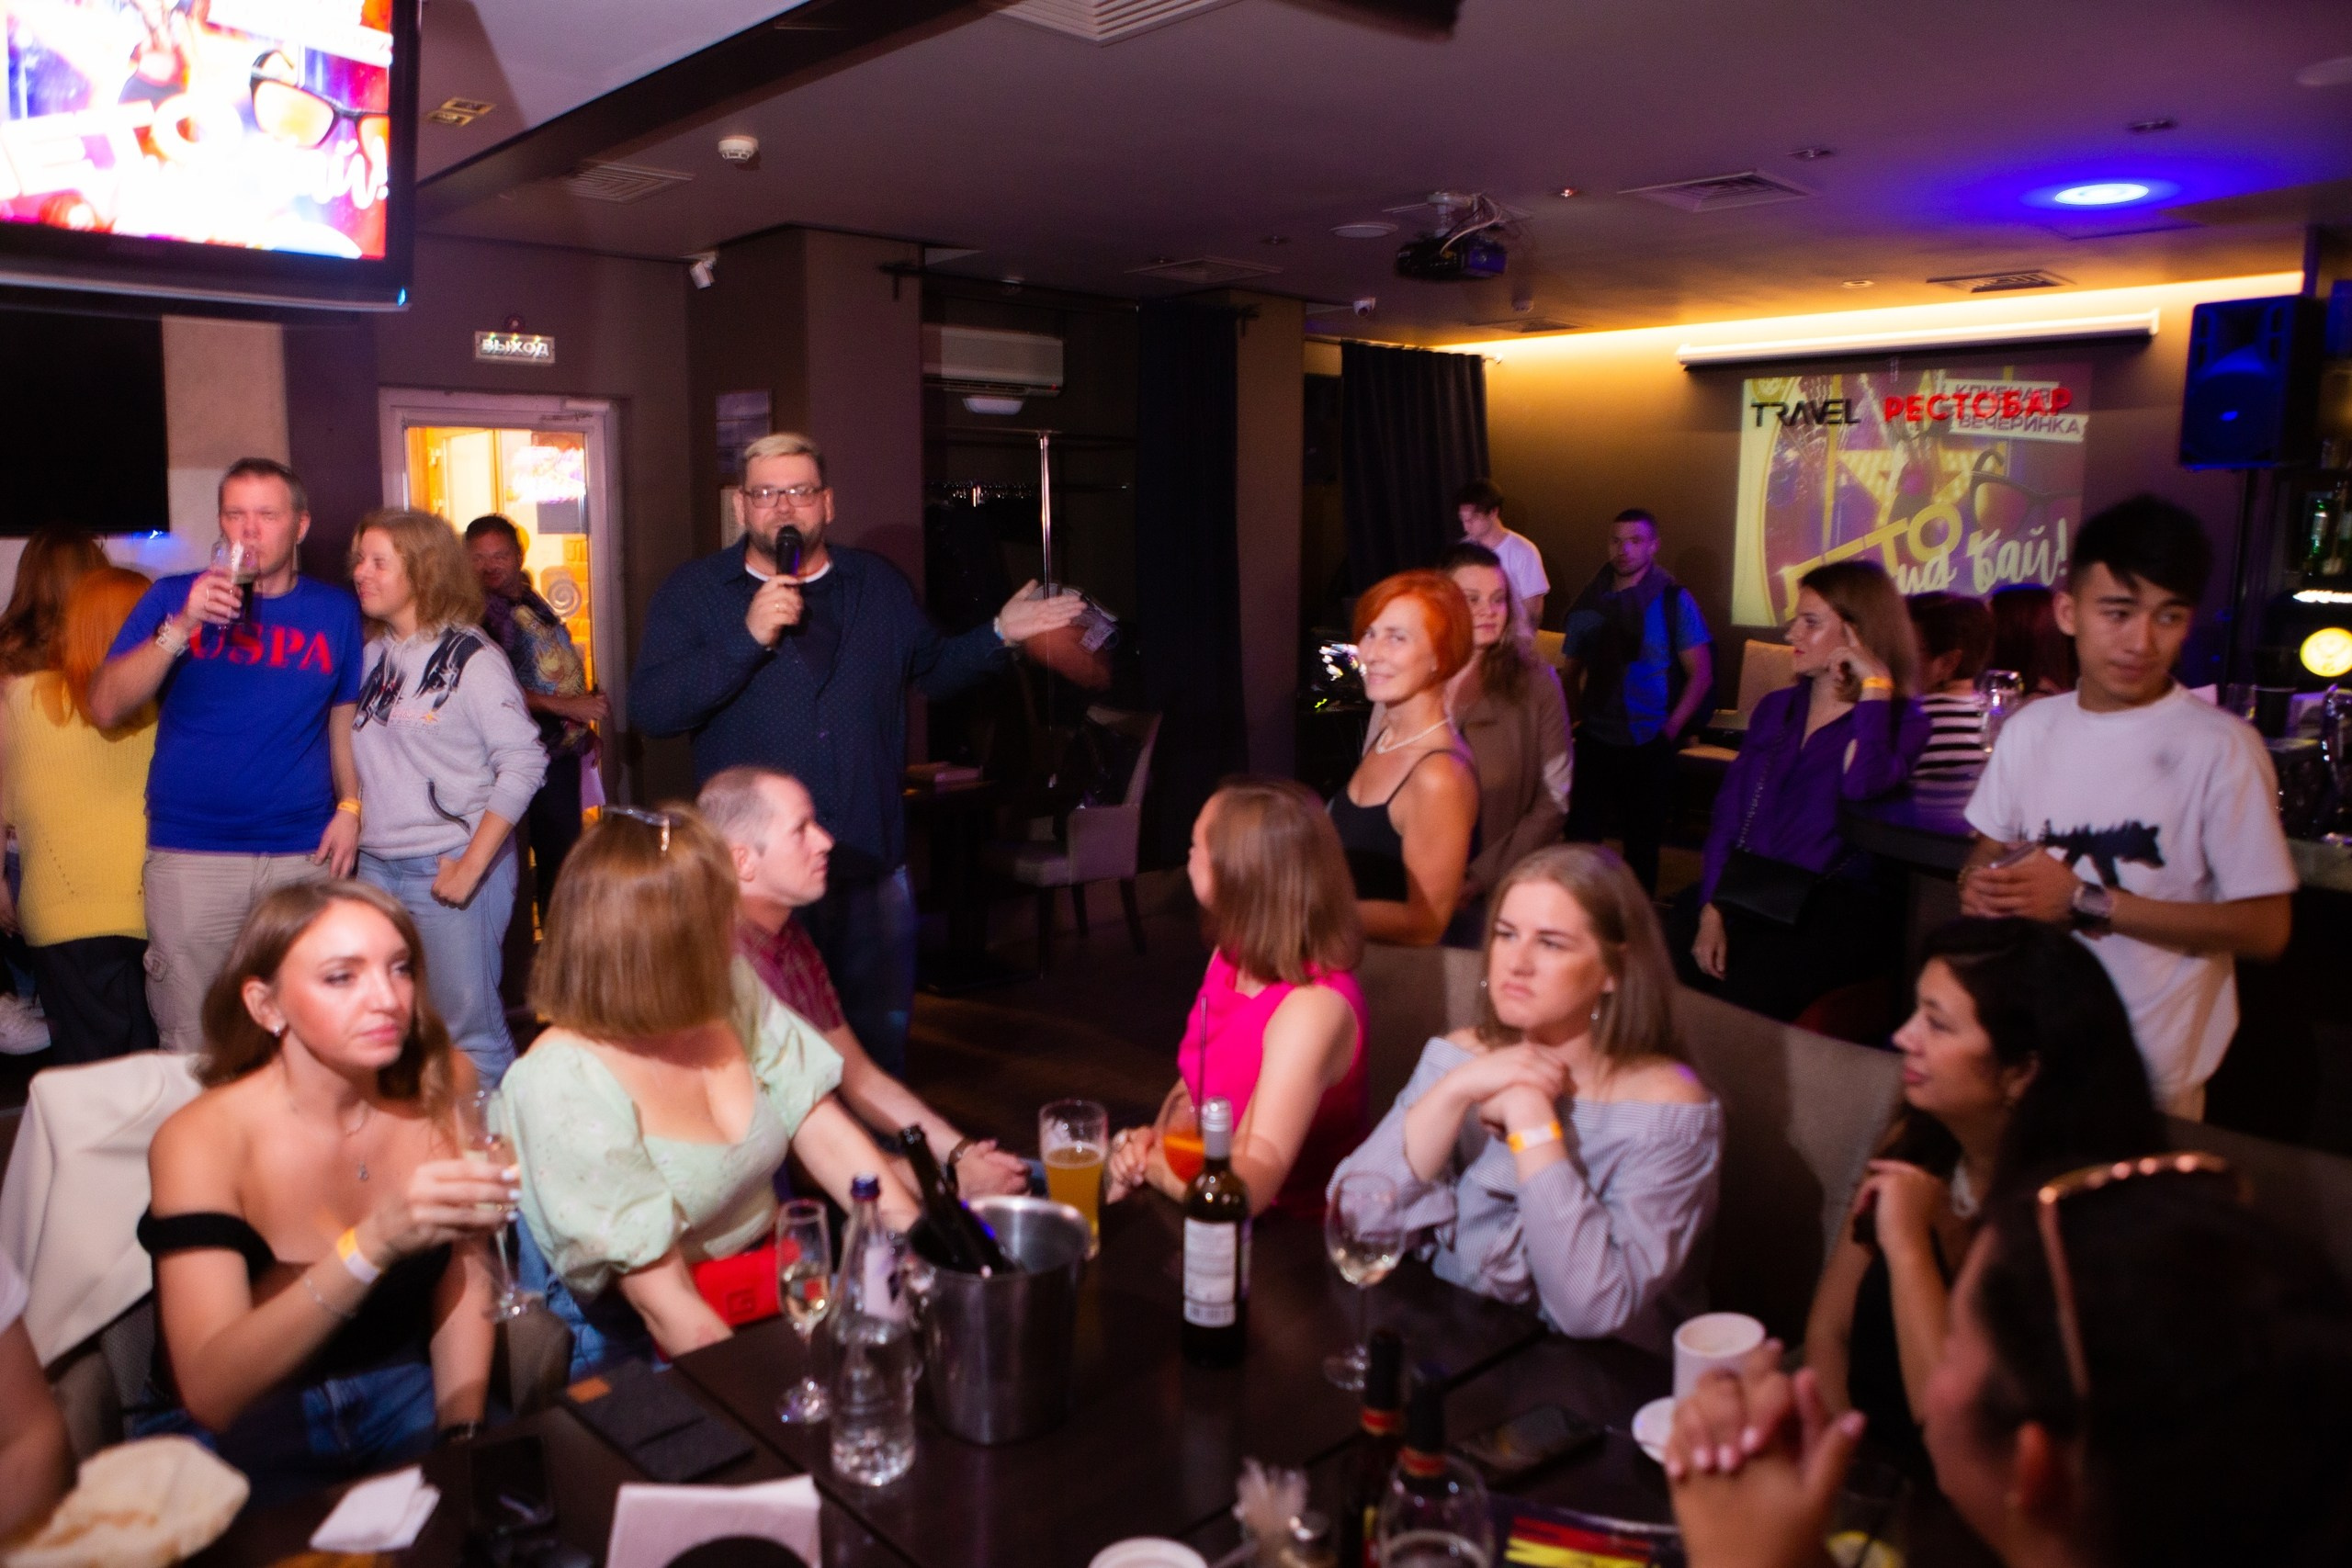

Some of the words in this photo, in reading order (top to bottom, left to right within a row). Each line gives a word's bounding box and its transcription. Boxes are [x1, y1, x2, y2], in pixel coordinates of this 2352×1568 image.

[481, 337, 549, 357] ВЫХОД
[1751, 399, 1861, 427] TRAVEL
[1884, 387, 2073, 422] РЕСТОБАР
[1958, 414, 2081, 434] ВЕЧЕРИНКА
[189, 621, 333, 675] USPA
